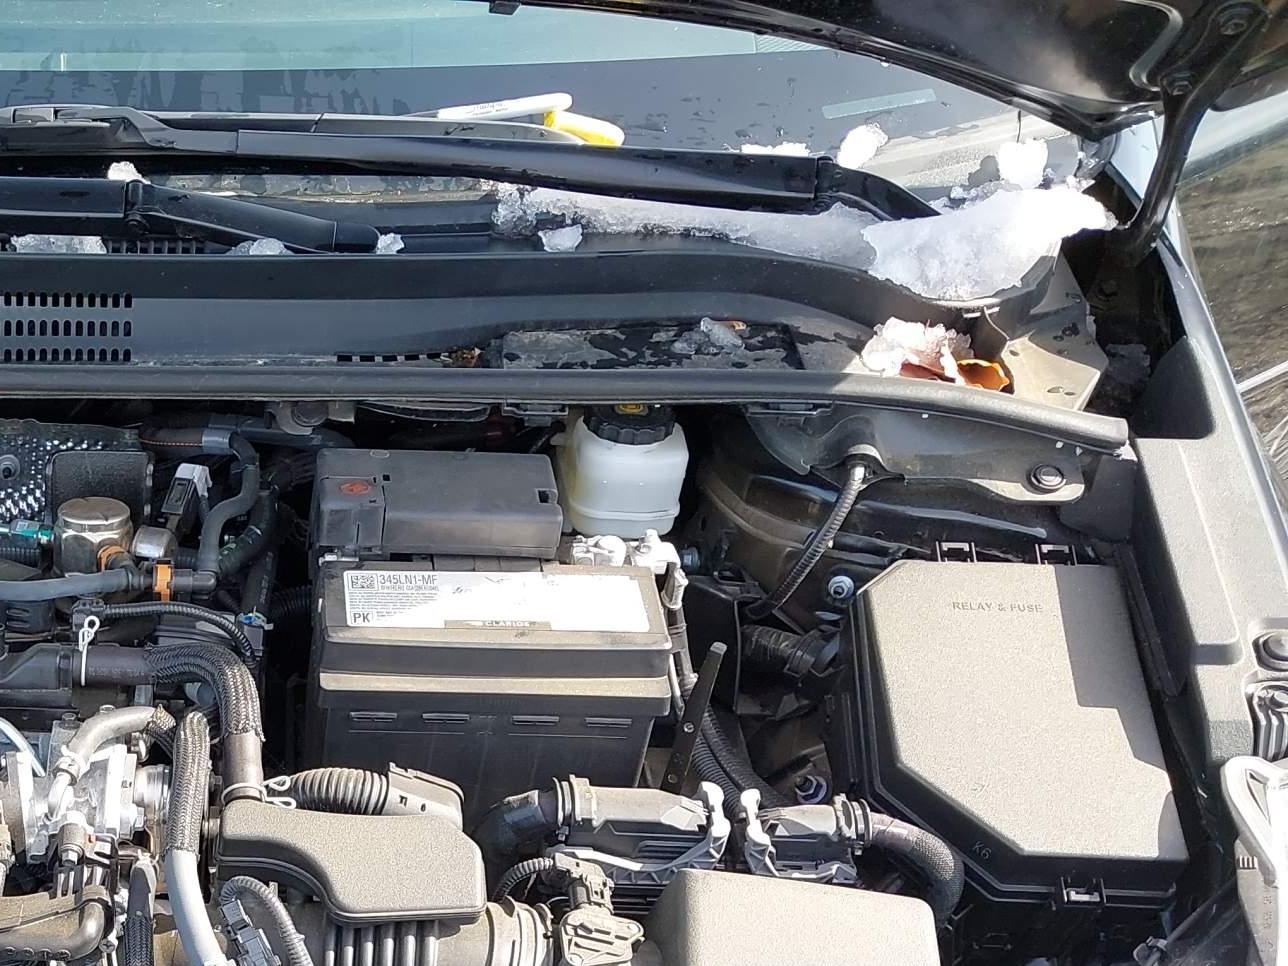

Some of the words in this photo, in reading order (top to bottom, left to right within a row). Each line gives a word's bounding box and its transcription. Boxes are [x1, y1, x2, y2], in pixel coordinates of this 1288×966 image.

[379, 574, 438, 585] 345LN1-MF
[952, 602, 992, 611] RELAY
[997, 603, 1007, 612] &
[1010, 603, 1043, 612] FUSE
[352, 613, 370, 624] PK
[972, 841, 992, 860] K6
